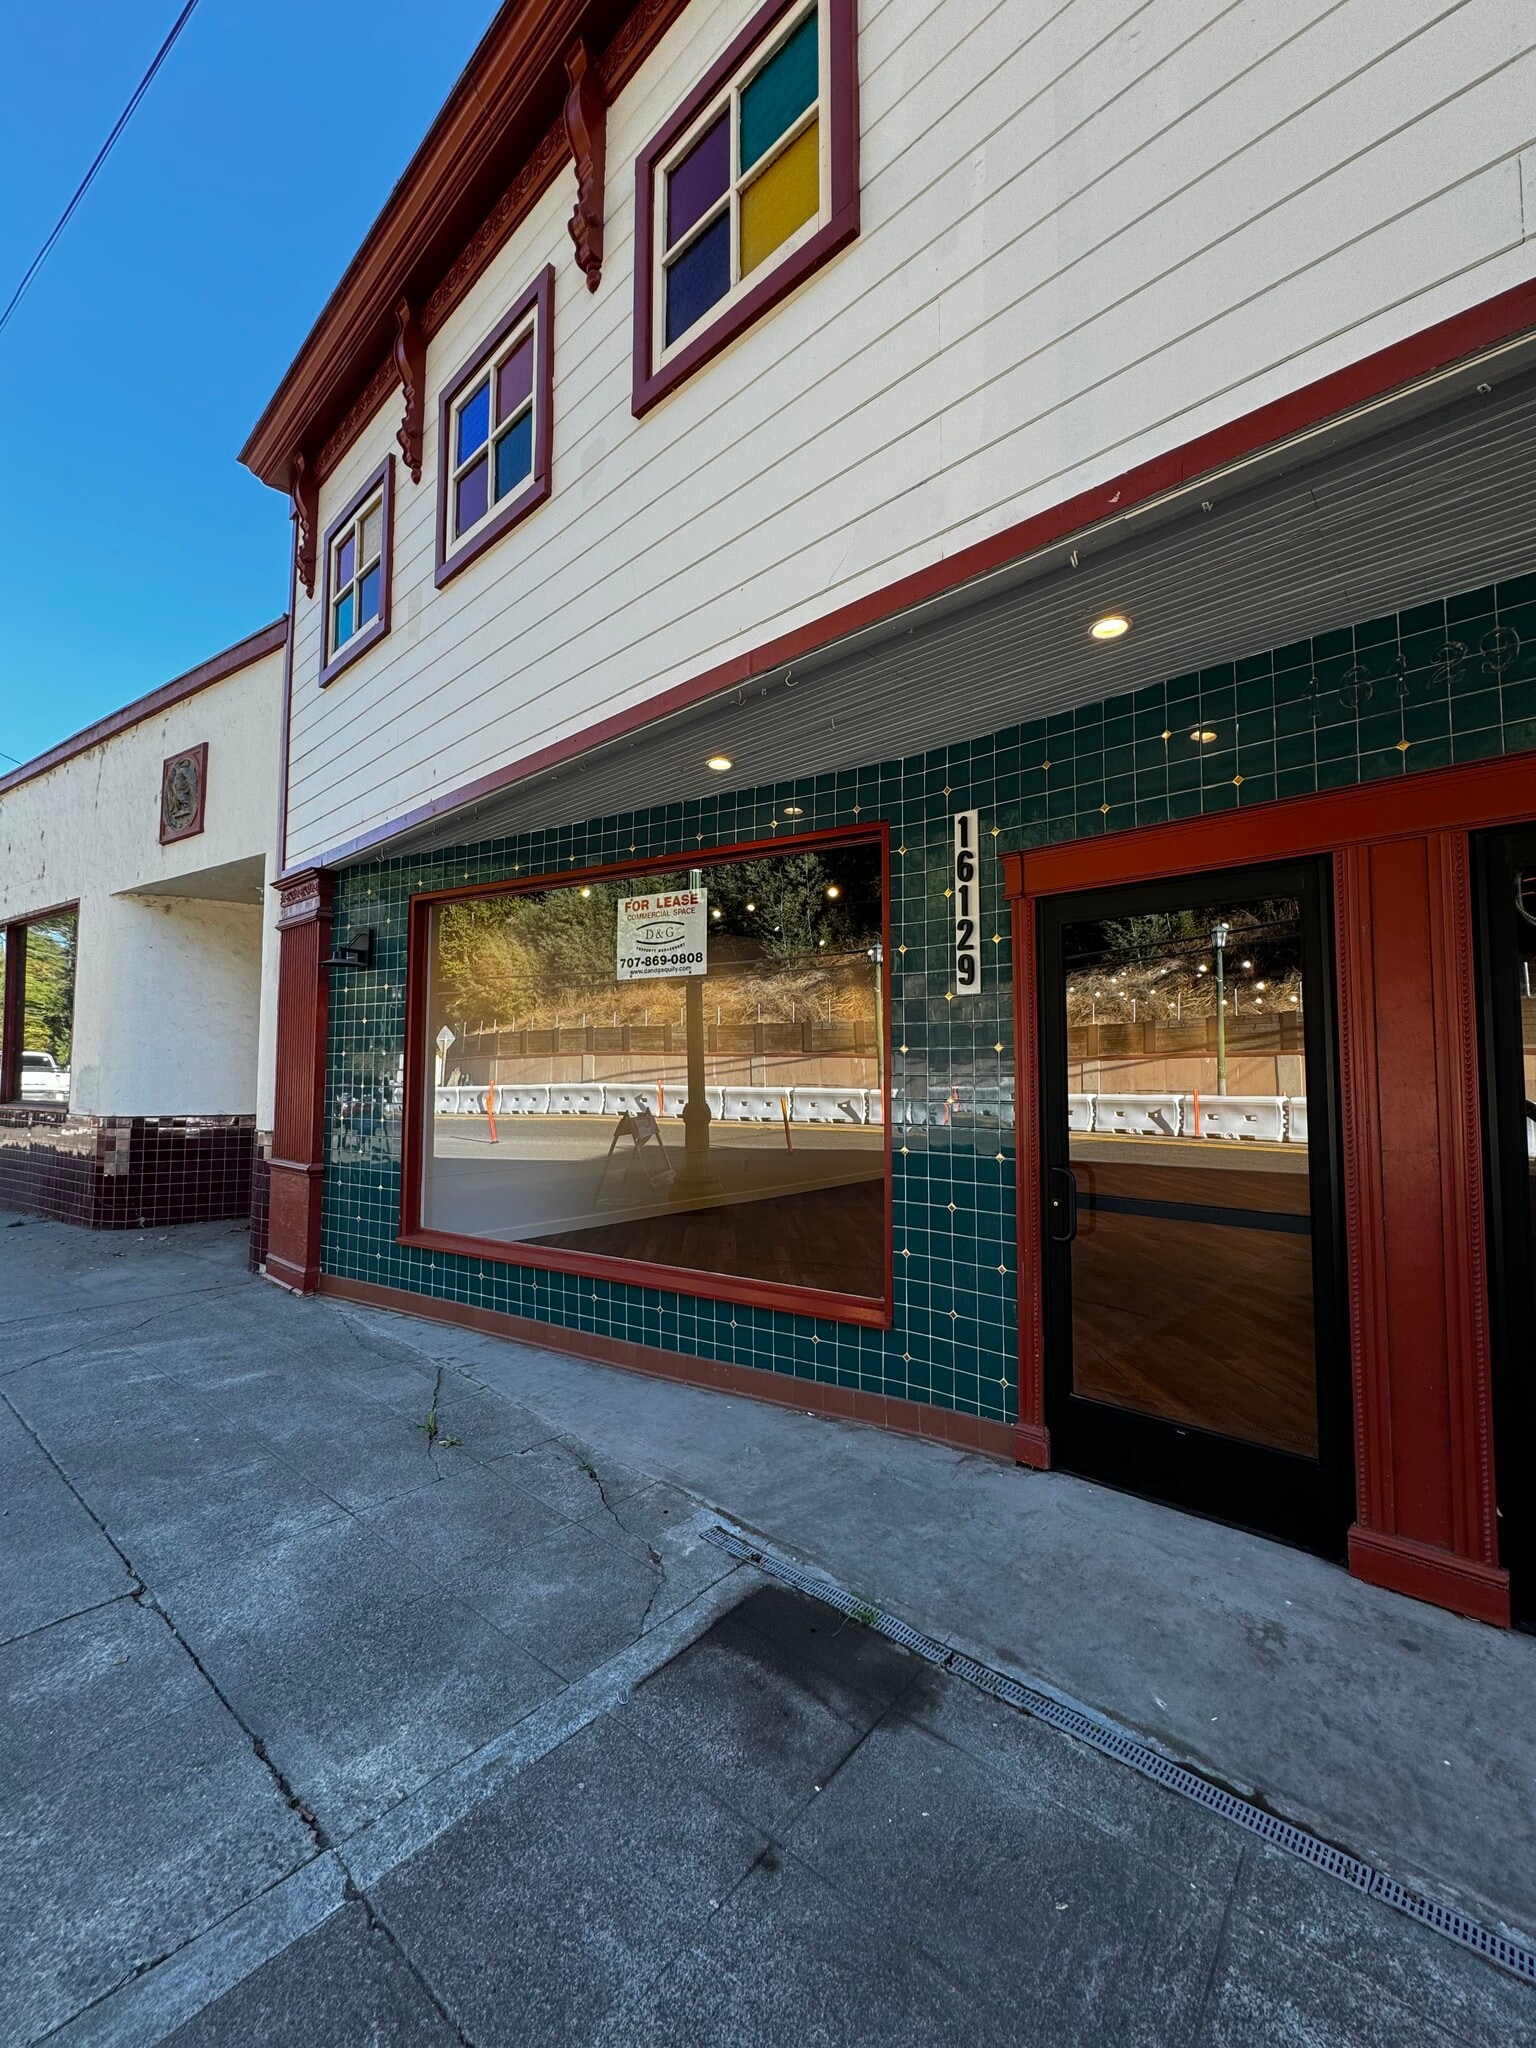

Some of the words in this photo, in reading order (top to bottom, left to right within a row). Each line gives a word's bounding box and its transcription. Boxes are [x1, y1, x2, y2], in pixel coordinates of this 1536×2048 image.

[624, 900, 649, 912] FOR
[656, 894, 699, 908] LEASE
[957, 816, 975, 986] 16129
[627, 911, 671, 921] COMMERCIAL
[673, 907, 696, 915] SPACE
[620, 952, 703, 968] 707-869-0808
[630, 965, 692, 975] www.dandgequity.com
